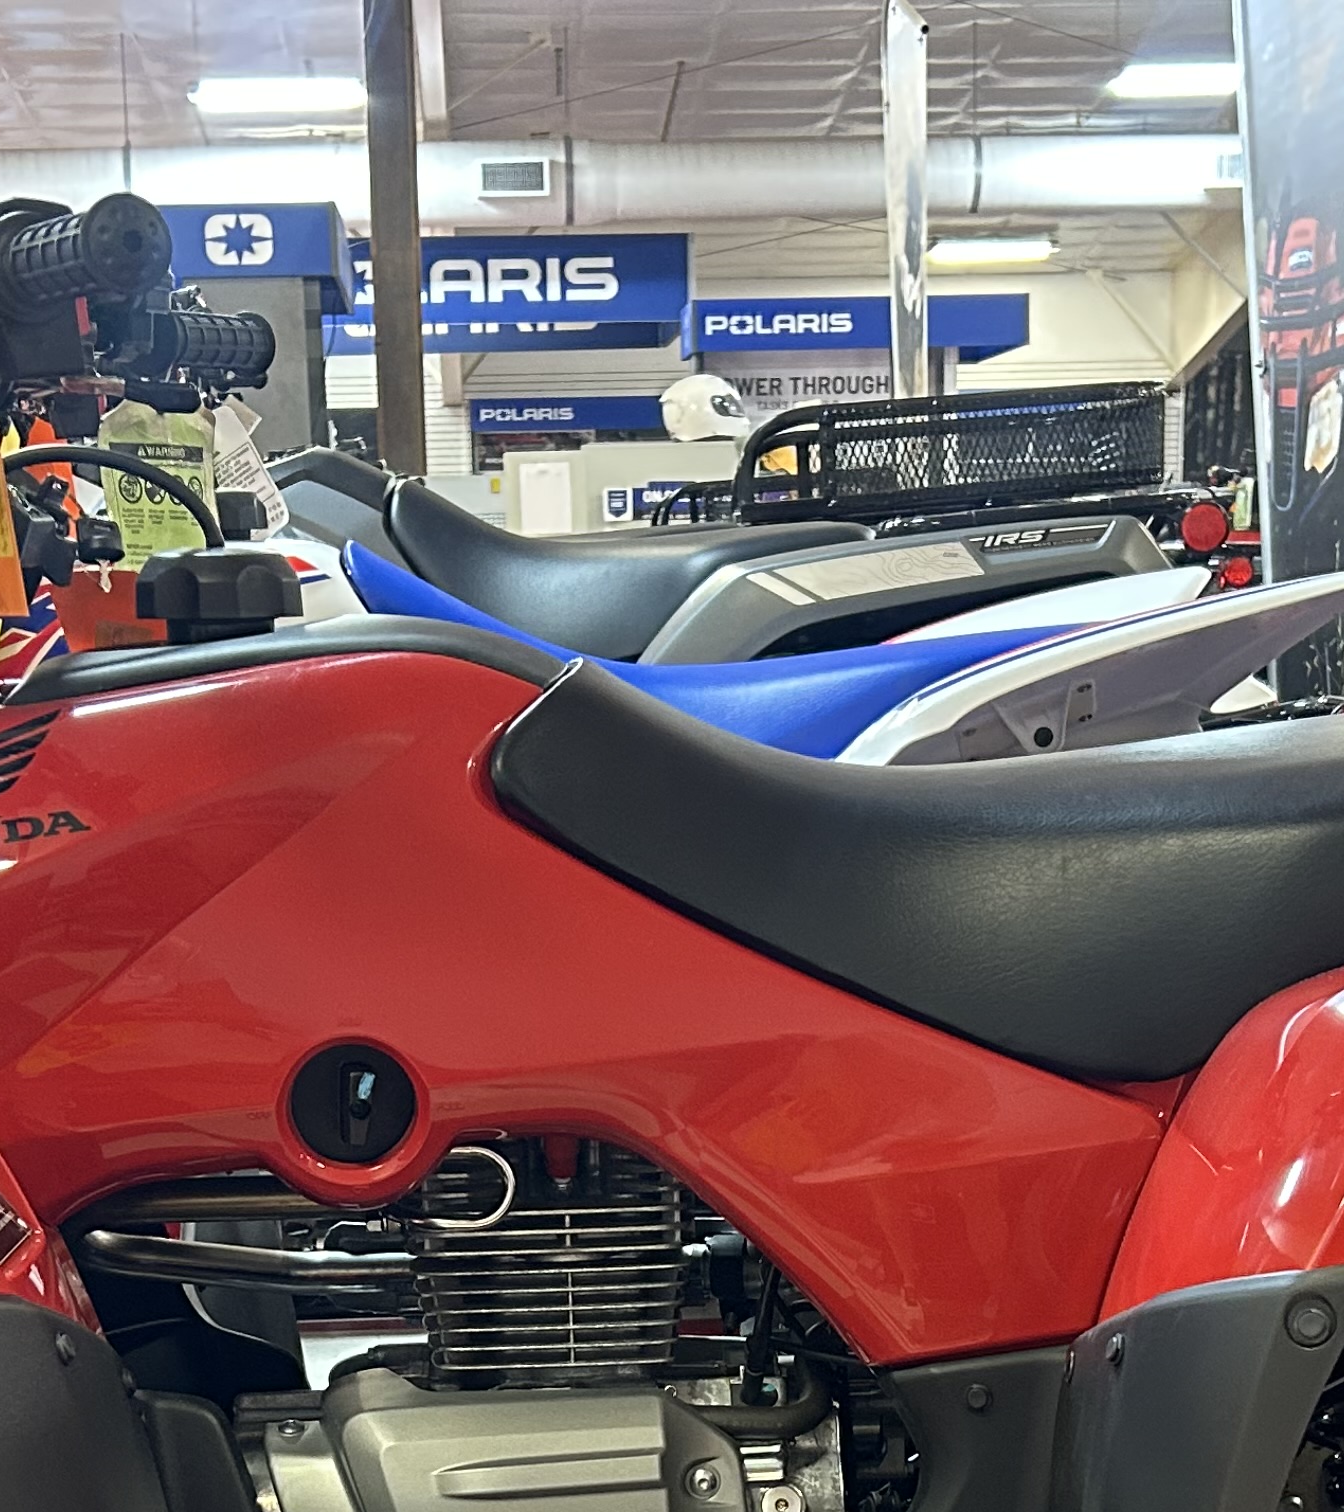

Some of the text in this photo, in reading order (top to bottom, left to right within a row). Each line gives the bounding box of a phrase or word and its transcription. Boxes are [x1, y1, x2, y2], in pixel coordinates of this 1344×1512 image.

[353, 256, 619, 304] ARIS
[705, 313, 853, 335] POLARIS
[724, 375, 890, 397] WER THROUGH
[480, 407, 575, 423] POLARIS
[984, 530, 1046, 547] IRS
